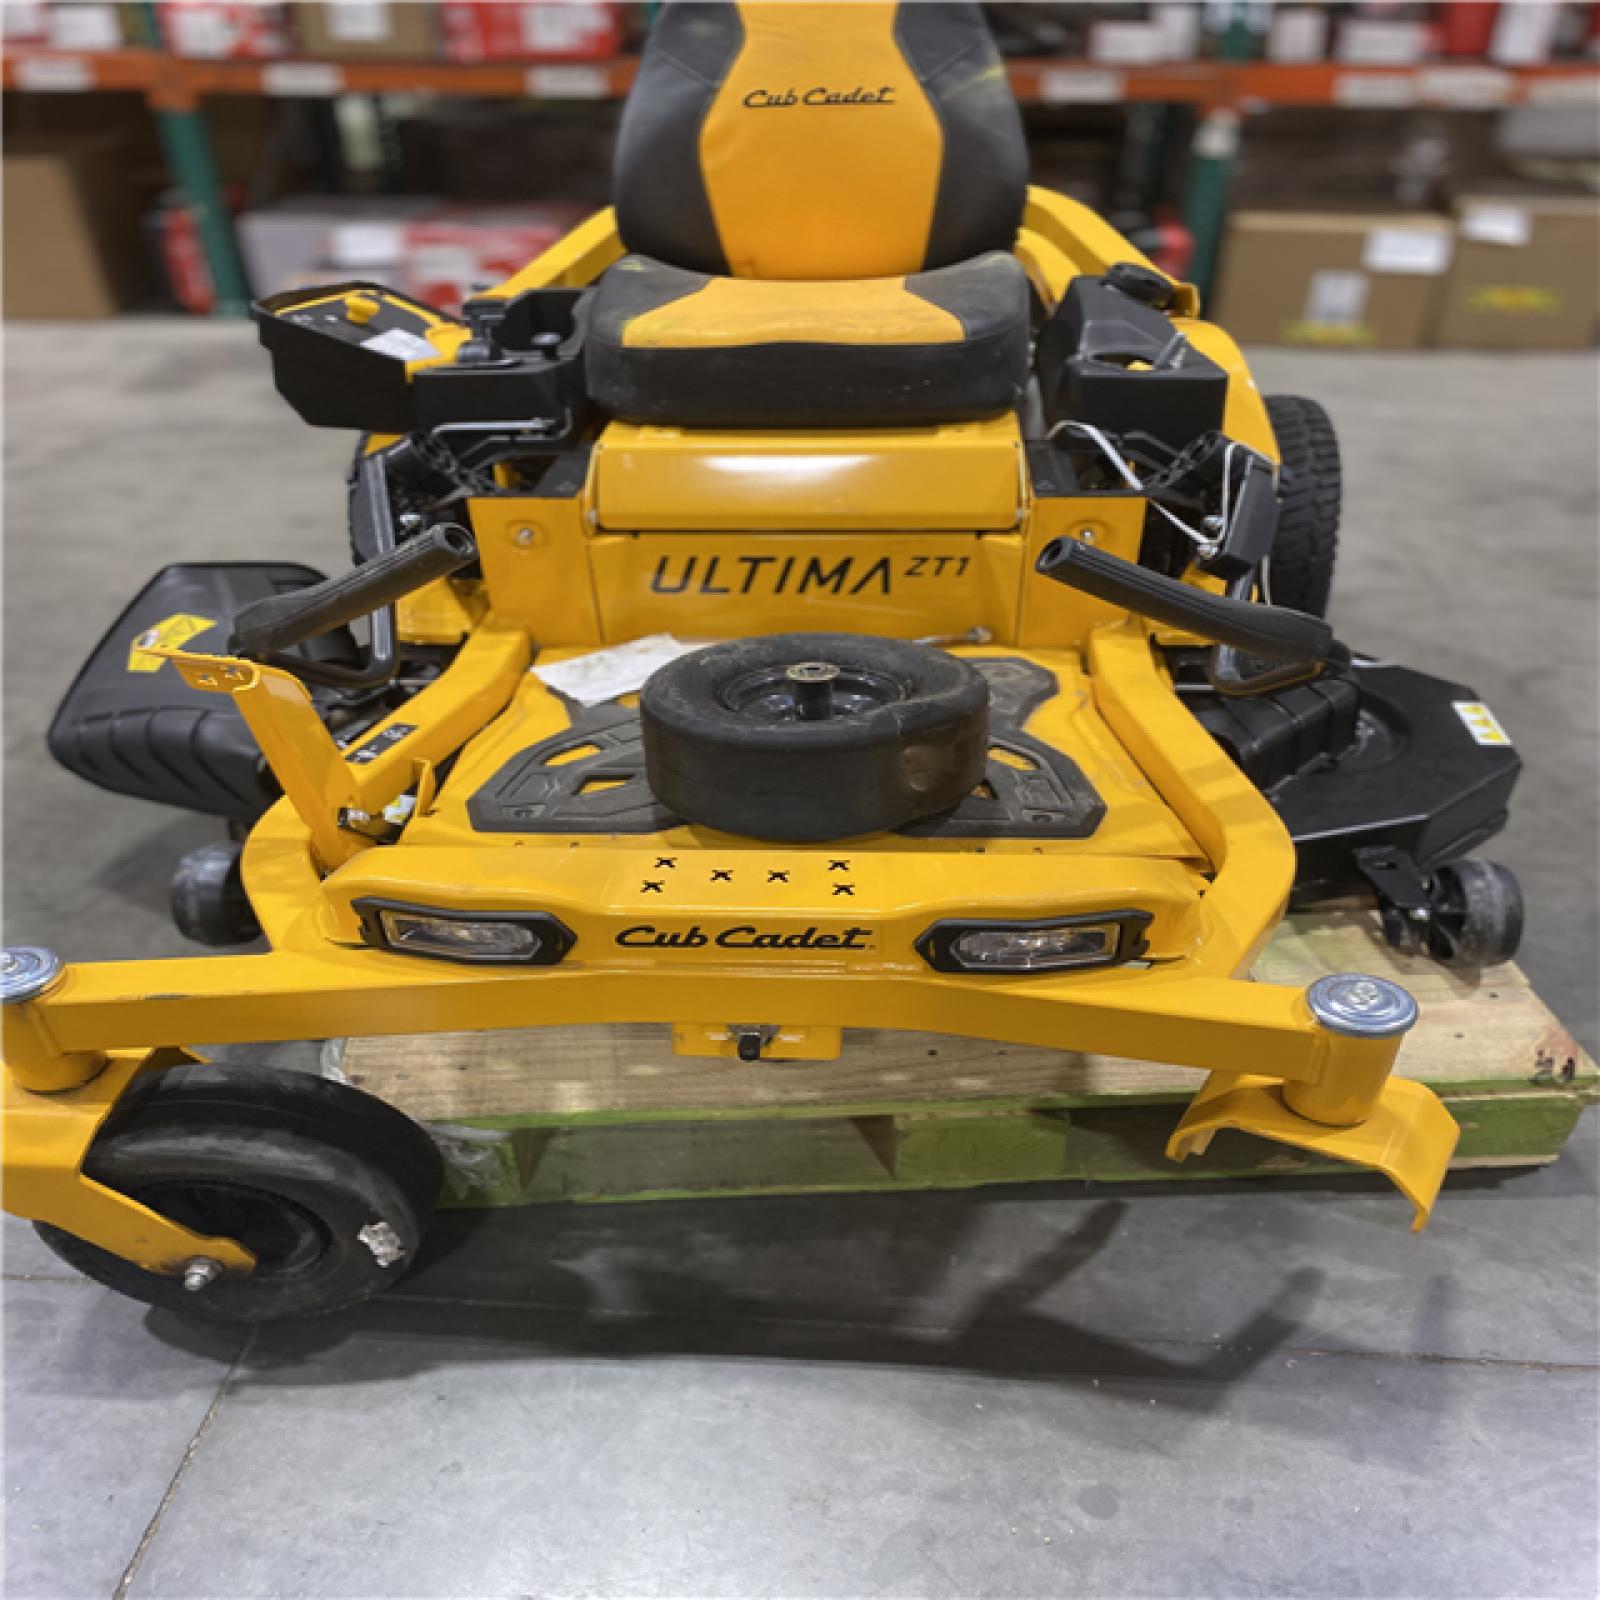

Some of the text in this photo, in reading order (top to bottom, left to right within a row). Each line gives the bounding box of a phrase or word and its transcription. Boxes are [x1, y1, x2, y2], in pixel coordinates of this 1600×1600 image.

[743, 86, 896, 108] Cub Cadet
[651, 556, 971, 595] ULTIMA ZT1
[615, 925, 873, 949] Cub Cadet
